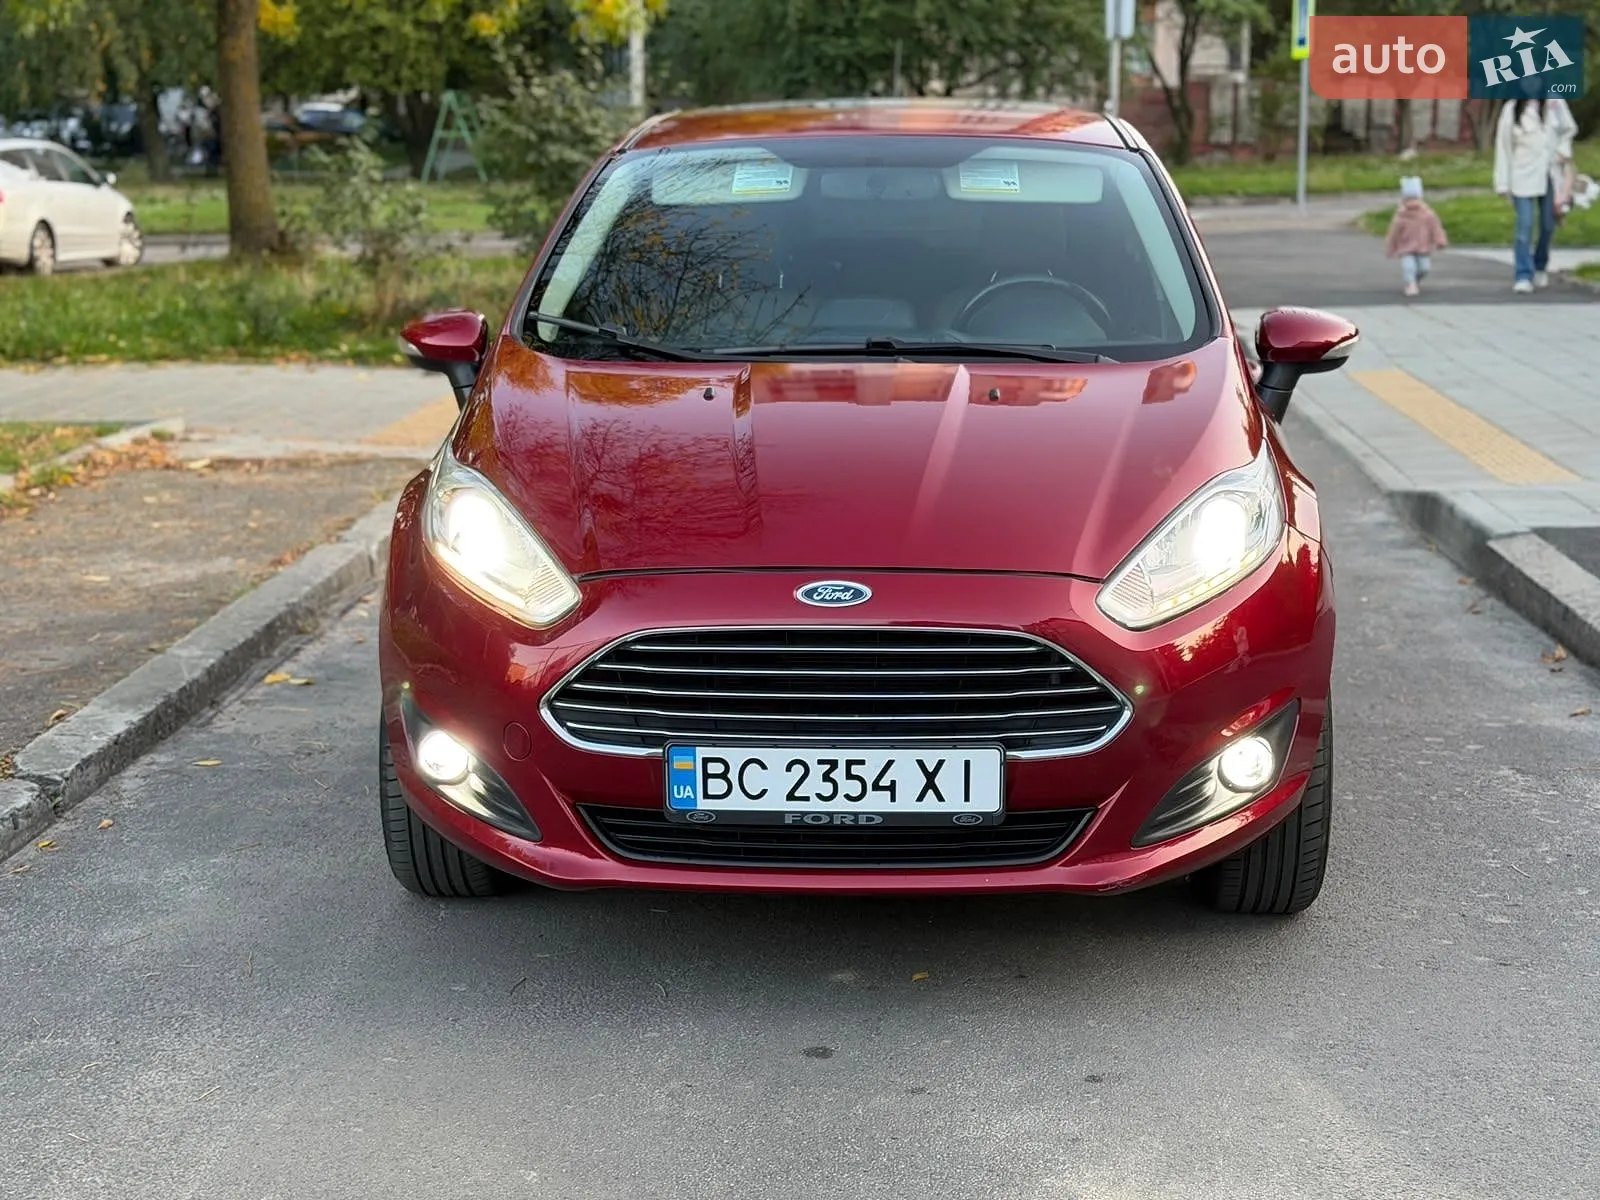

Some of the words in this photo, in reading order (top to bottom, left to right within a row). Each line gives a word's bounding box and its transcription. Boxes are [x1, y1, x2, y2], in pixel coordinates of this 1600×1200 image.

[813, 586, 854, 600] Ford
[701, 757, 769, 800] BC
[785, 759, 897, 803] 2354
[673, 785, 695, 799] UA
[784, 813, 883, 825] FORD
